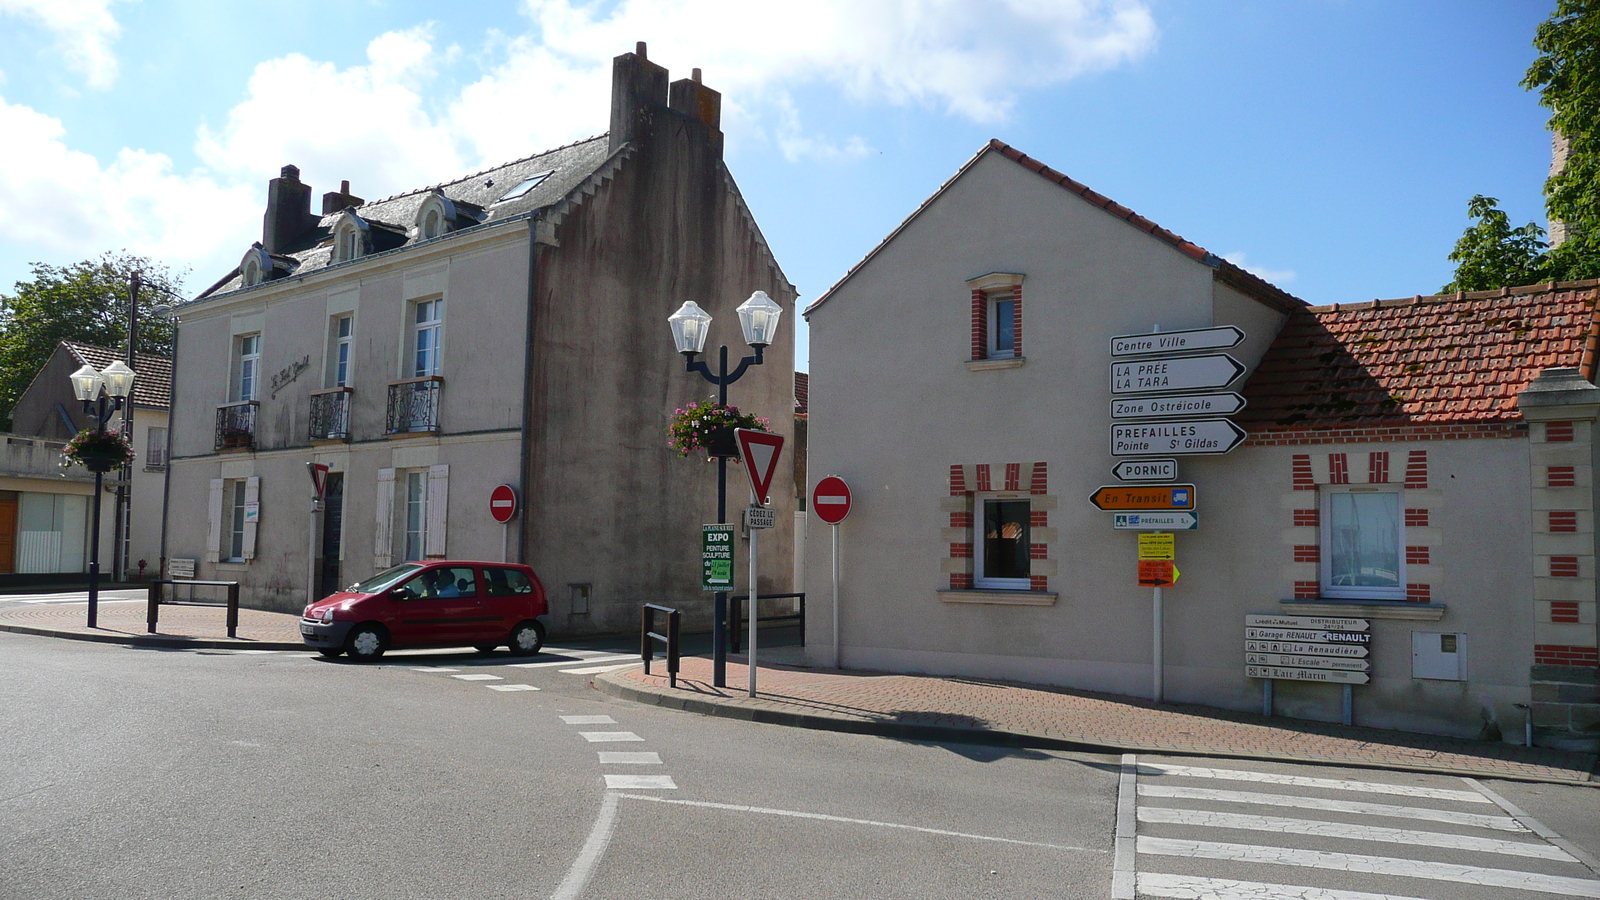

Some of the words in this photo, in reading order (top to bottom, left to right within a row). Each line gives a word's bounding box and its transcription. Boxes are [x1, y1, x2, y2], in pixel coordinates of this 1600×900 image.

[1116, 341, 1152, 351] Centre
[1160, 337, 1186, 347] Ville
[1117, 366, 1131, 377] LA
[1138, 362, 1168, 375] PRÉE
[1117, 379, 1131, 389] LA
[1138, 376, 1169, 388] TARA
[1116, 404, 1144, 414] Zone
[1150, 399, 1212, 412] Ostréicole
[1116, 426, 1196, 439] PREFAILLES
[1117, 441, 1150, 451] Pointe
[1184, 438, 1218, 449] Gildas
[1126, 465, 1170, 476] PORNIC
[1104, 494, 1119, 503] En
[1126, 493, 1167, 503] Transit
[749, 509, 766, 518] CÉDEZ
[750, 518, 773, 526] PASSAGE
[1141, 516, 1174, 524] PRÉFAILLES
[707, 533, 729, 542] EXPO
[1259, 630, 1284, 639] Garage
[1286, 631, 1318, 640] RENAULT
[1326, 632, 1371, 643] RENAULT
[1308, 646, 1358, 655] Renaudière
[1292, 657, 1320, 666] L'Escale
[1331, 661, 1362, 669] permanent
[1296, 670, 1327, 680] Marin
